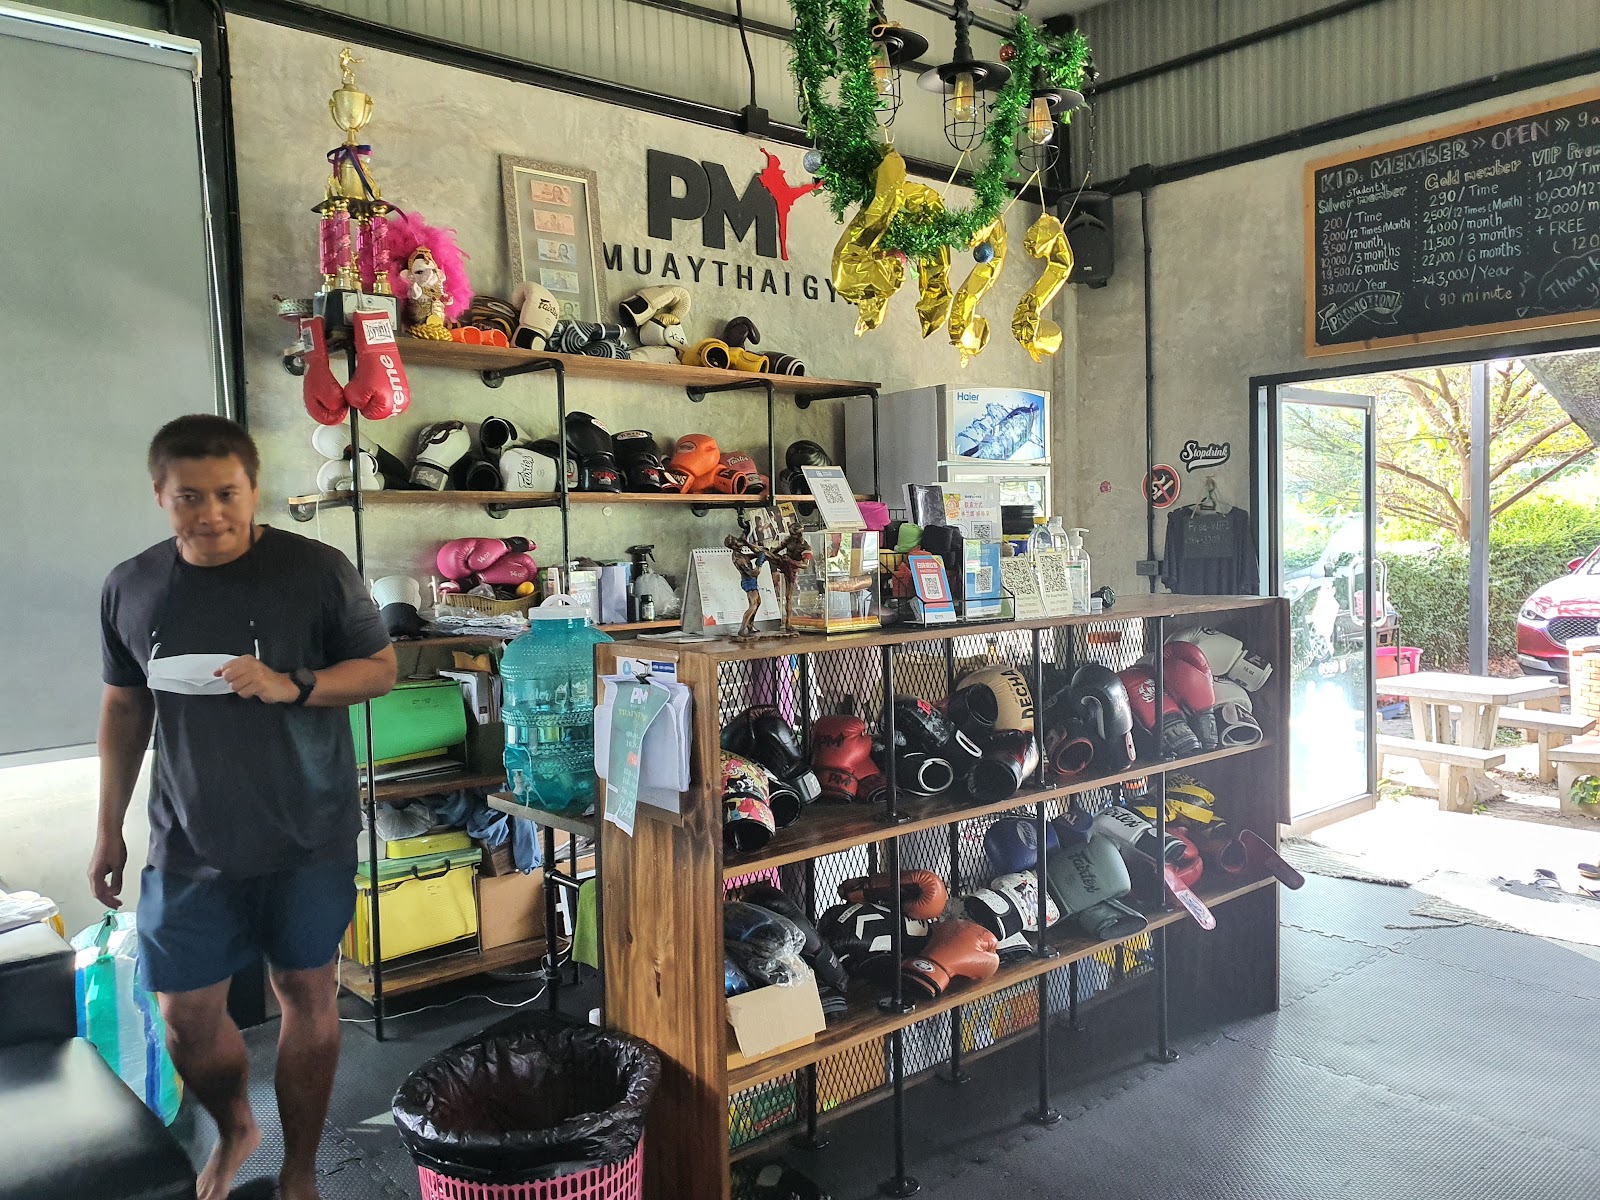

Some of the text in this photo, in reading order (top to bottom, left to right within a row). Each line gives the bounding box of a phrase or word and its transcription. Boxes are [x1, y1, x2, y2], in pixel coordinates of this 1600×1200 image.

[1371, 140, 1470, 179] MEMBER
[1492, 120, 1549, 149] OPEN
[1532, 146, 1561, 167] VIP
[1425, 160, 1522, 190] Gold member
[1318, 185, 1408, 214] Silver member
[1469, 184, 1499, 196] Time
[648, 149, 778, 258] PM
[1464, 206, 1487, 214] Times
[1355, 210, 1383, 224] Time
[1467, 212, 1503, 229] month
[1549, 217, 1586, 236] FREE
[1468, 233, 1476, 244] 3
[1479, 225, 1523, 242] months
[1364, 243, 1401, 261] months
[1468, 249, 1476, 262] 6
[1480, 242, 1522, 259] months
[1364, 257, 1400, 274] months
[1479, 265, 1514, 279] Year
[1364, 277, 1388, 290] Year
[1462, 284, 1513, 303] minute
[957, 392, 979, 401] Haier
[1000, 669, 1034, 720] DECHA
